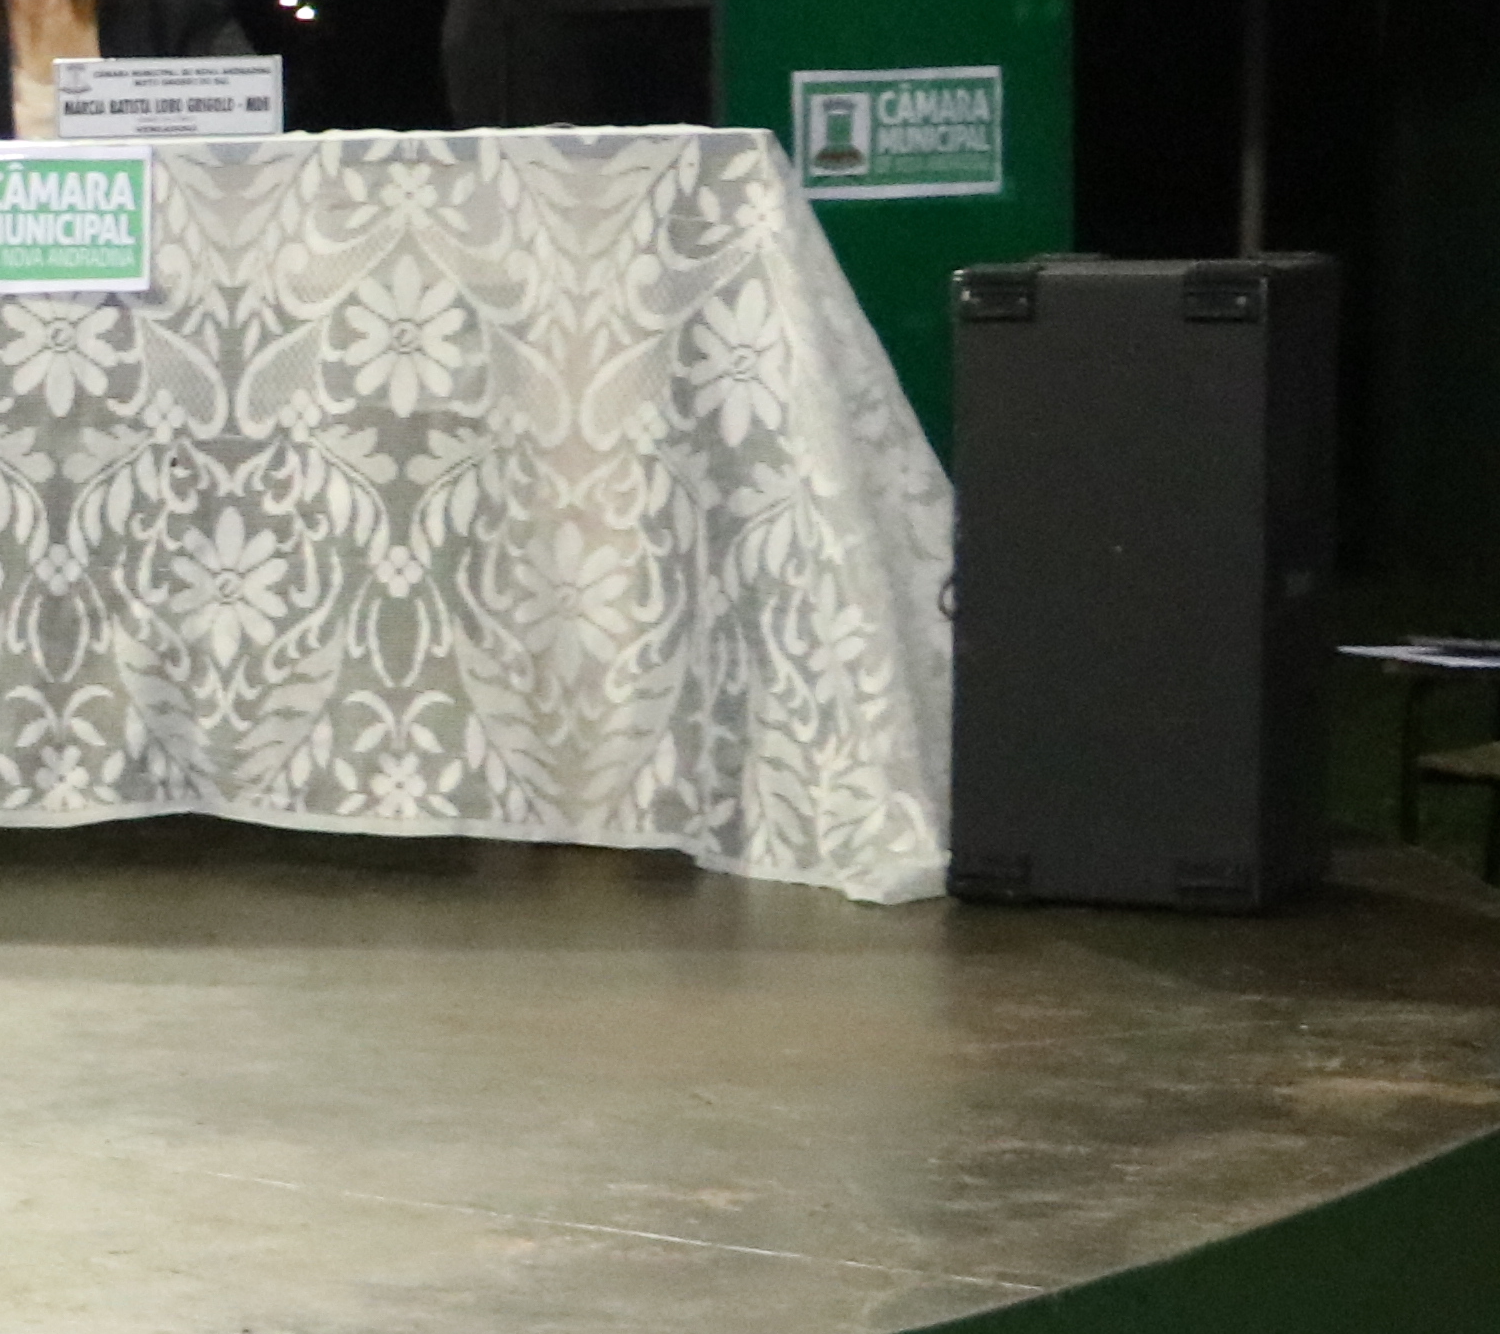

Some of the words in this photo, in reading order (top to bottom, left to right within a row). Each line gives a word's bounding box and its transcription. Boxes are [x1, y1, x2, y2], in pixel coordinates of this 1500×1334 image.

[877, 83, 990, 124] CÂMARA
[877, 125, 990, 154] MUNICIPAL
[2, 248, 43, 266] NOVA
[49, 247, 135, 266] ANDRADINA
